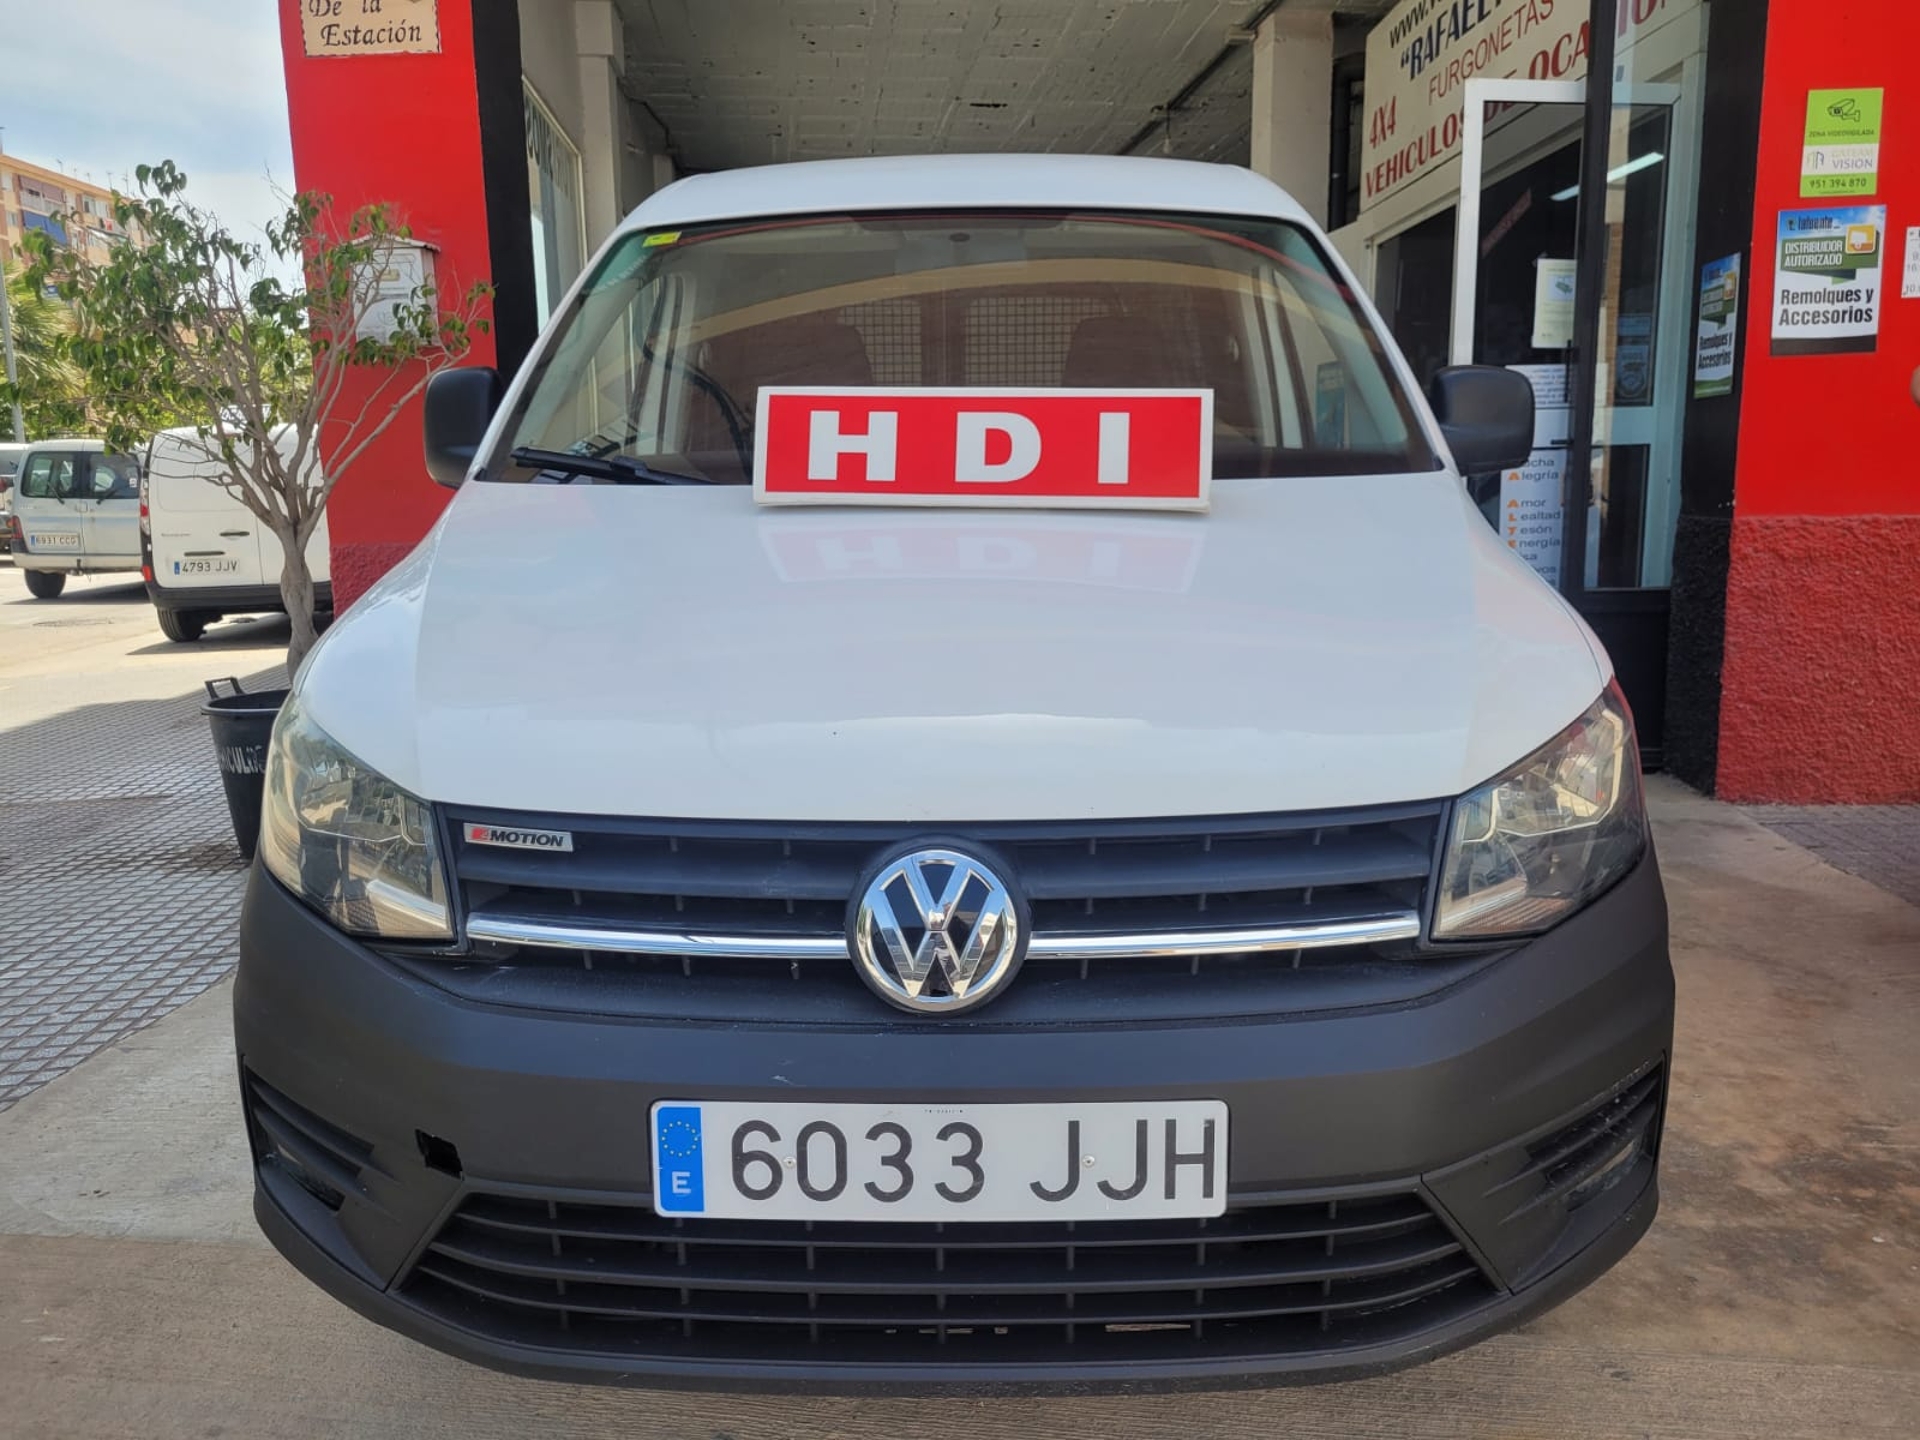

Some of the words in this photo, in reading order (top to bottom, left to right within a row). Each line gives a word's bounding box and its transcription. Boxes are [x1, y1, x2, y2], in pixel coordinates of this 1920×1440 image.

[320, 19, 422, 46] Estación
[1429, 0, 1554, 106] FURGONETAS
[1369, 96, 1396, 149] 4X4
[1833, 159, 1873, 169] VISION
[1809, 180, 1826, 189] 951
[1849, 177, 1867, 187] 870
[1785, 240, 1843, 254] DISTRIBUIDOR
[1784, 253, 1843, 267] AUTORIZADO
[1780, 287, 1862, 306] Remolques
[1865, 288, 1874, 304] y
[1779, 306, 1873, 326] Accesorios
[807, 410, 1130, 484] HDI
[1508, 470, 1559, 482] Alegría
[1507, 499, 1546, 508] Amor
[1508, 511, 1561, 522] Lealtad
[1508, 524, 1552, 535] Tesón
[182, 562, 211, 572] 4793
[216, 561, 237, 572] JJV
[731, 1120, 985, 1202] 6033
[1029, 1118, 1215, 1202] JJH
[672, 1171, 691, 1195] E
